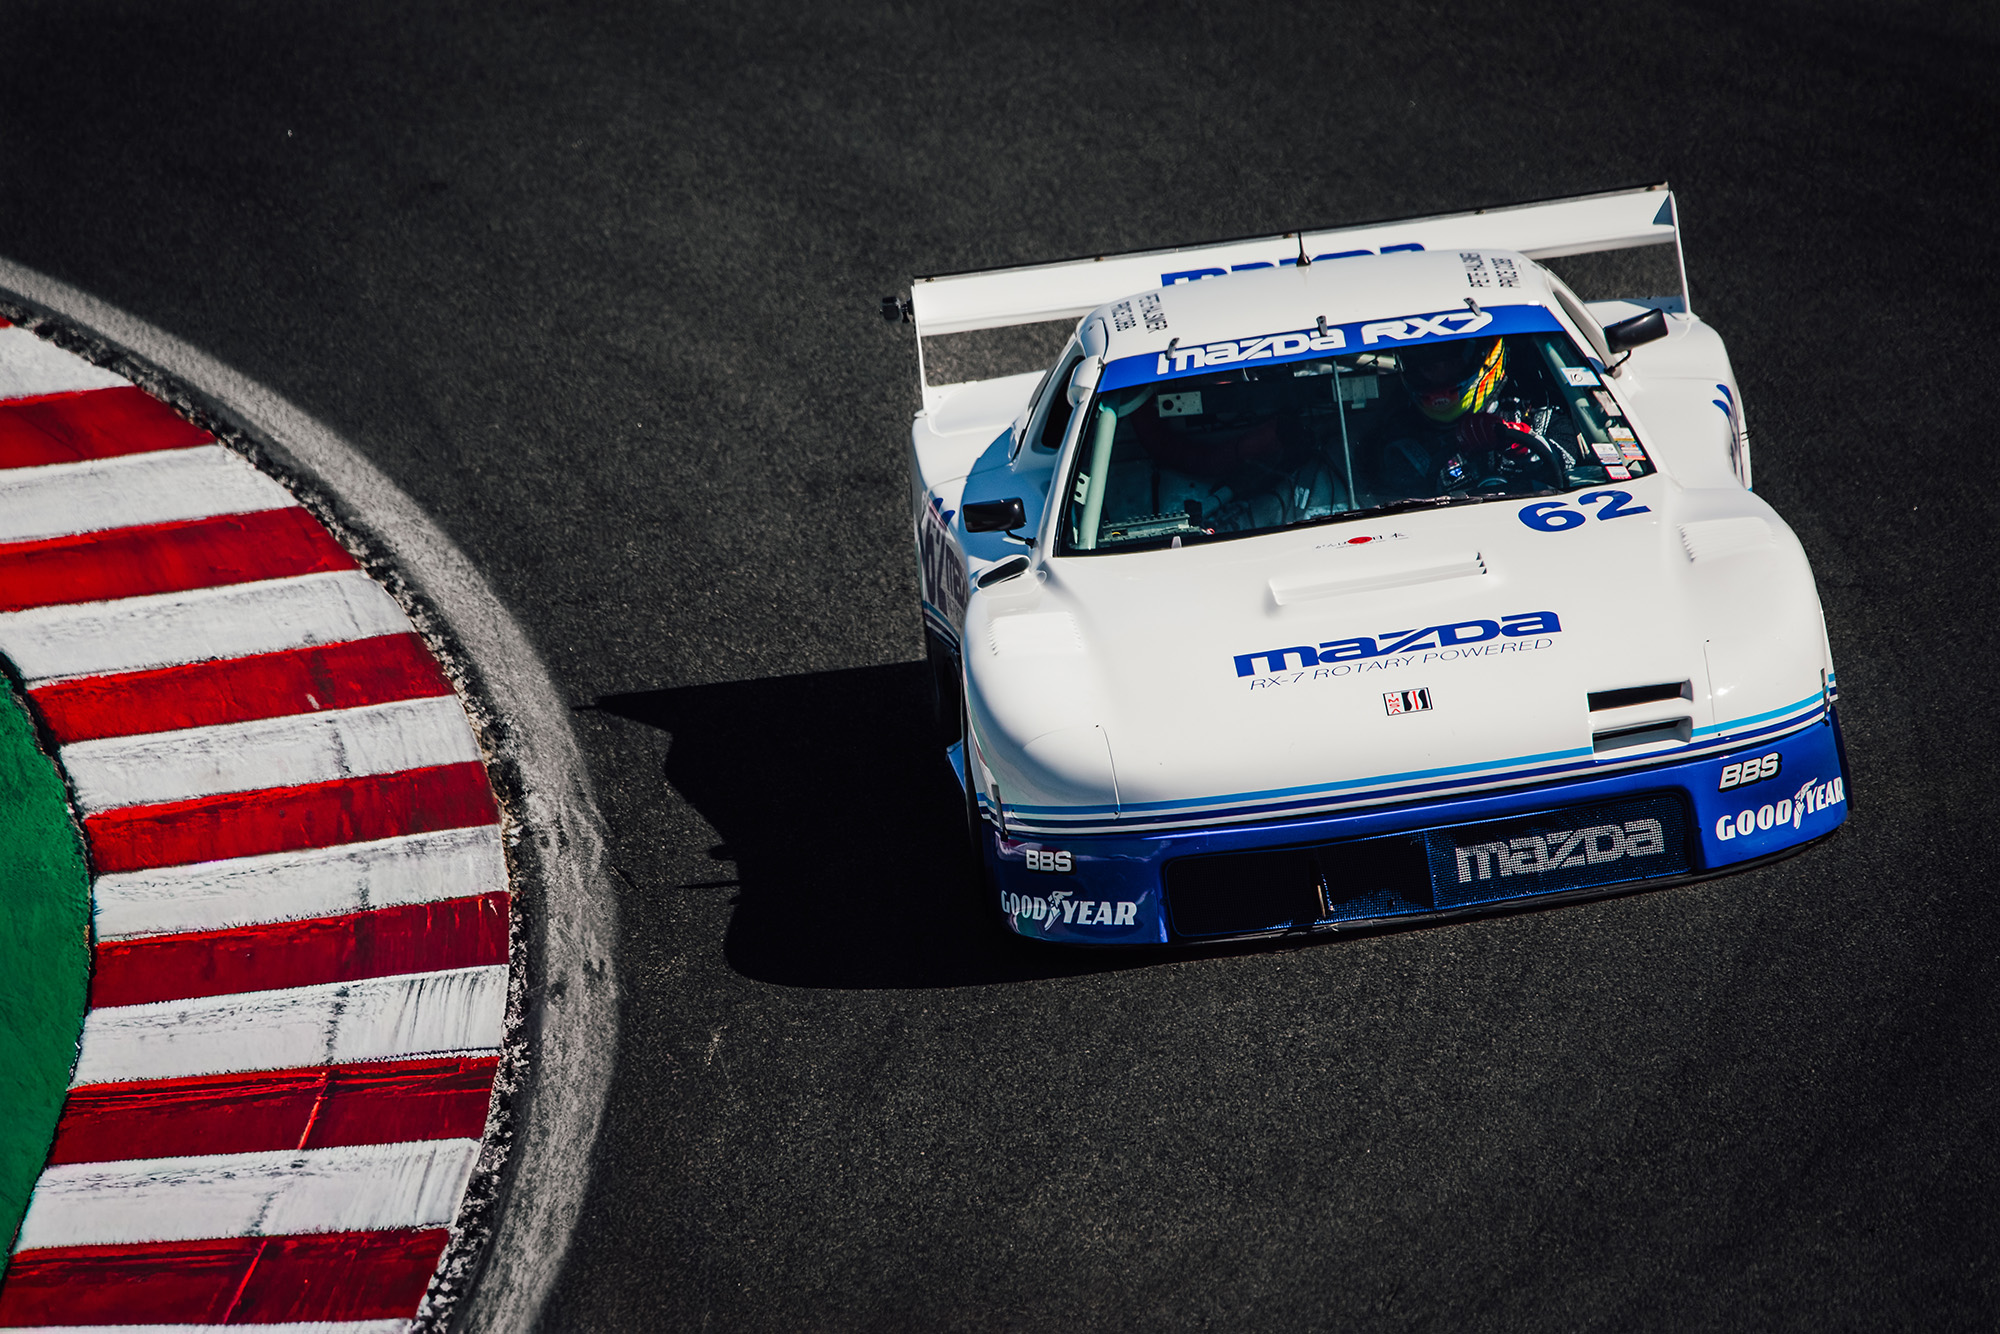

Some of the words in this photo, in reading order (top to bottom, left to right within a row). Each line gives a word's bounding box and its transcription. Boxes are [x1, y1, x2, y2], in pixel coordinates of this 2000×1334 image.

[1156, 328, 1345, 375] mazda
[1518, 490, 1651, 532] 62
[1233, 611, 1562, 677] mazda
[1250, 671, 1305, 691] RX-7
[1313, 655, 1415, 680] ROTARY
[1422, 638, 1553, 664] POWERED
[1719, 752, 1780, 790] BBS
[1025, 849, 1072, 872] BBS
[1455, 818, 1665, 884] mazda
